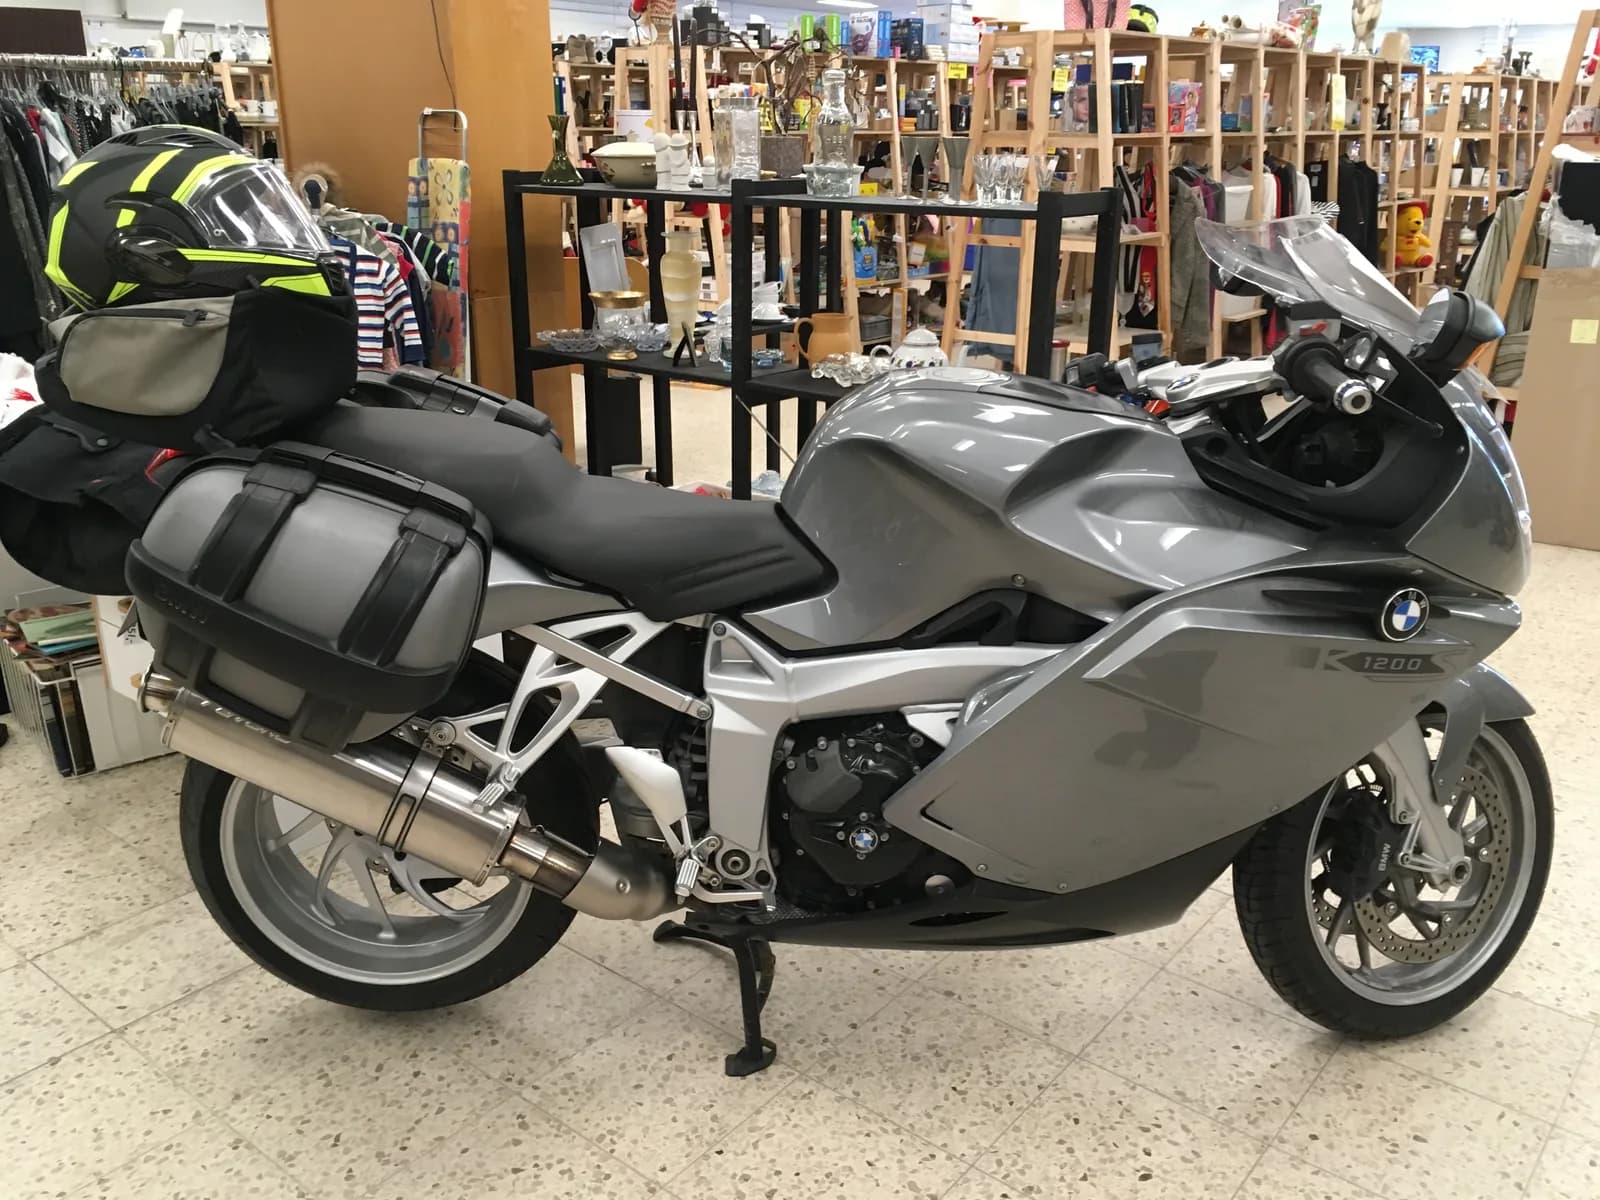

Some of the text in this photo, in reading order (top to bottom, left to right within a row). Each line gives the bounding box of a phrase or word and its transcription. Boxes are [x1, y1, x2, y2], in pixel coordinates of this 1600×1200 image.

[1313, 648, 1358, 672] K
[1363, 656, 1423, 671] 1200
[1378, 842, 1391, 871] BMW
